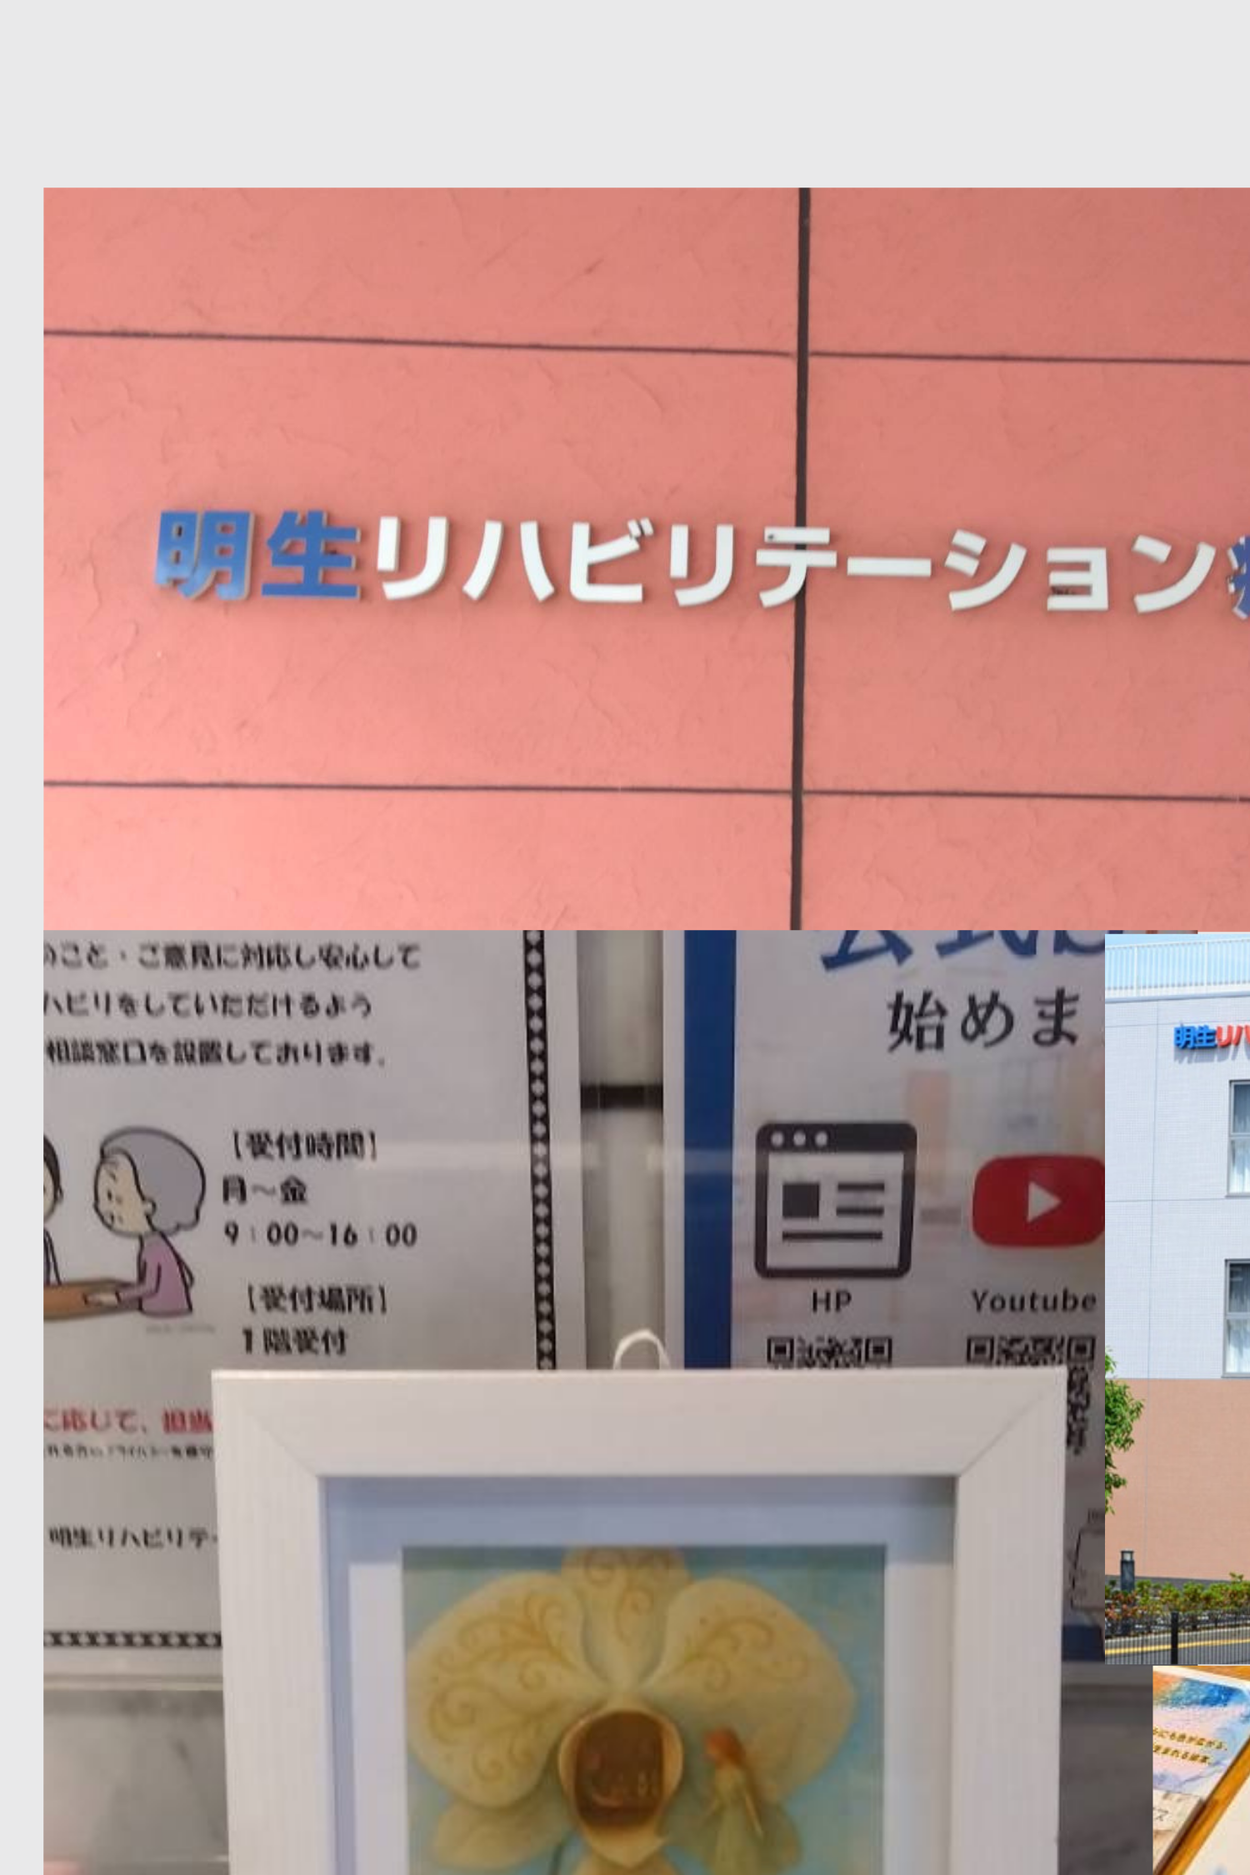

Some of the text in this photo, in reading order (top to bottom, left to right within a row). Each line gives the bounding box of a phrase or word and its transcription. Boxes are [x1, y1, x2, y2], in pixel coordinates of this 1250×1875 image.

[888, 986, 1081, 1054] 始めま
[812, 1290, 852, 1314] HP
[971, 1288, 1097, 1314] Youtube
[49, 1526, 218, 1548] 明生リハビリテ
